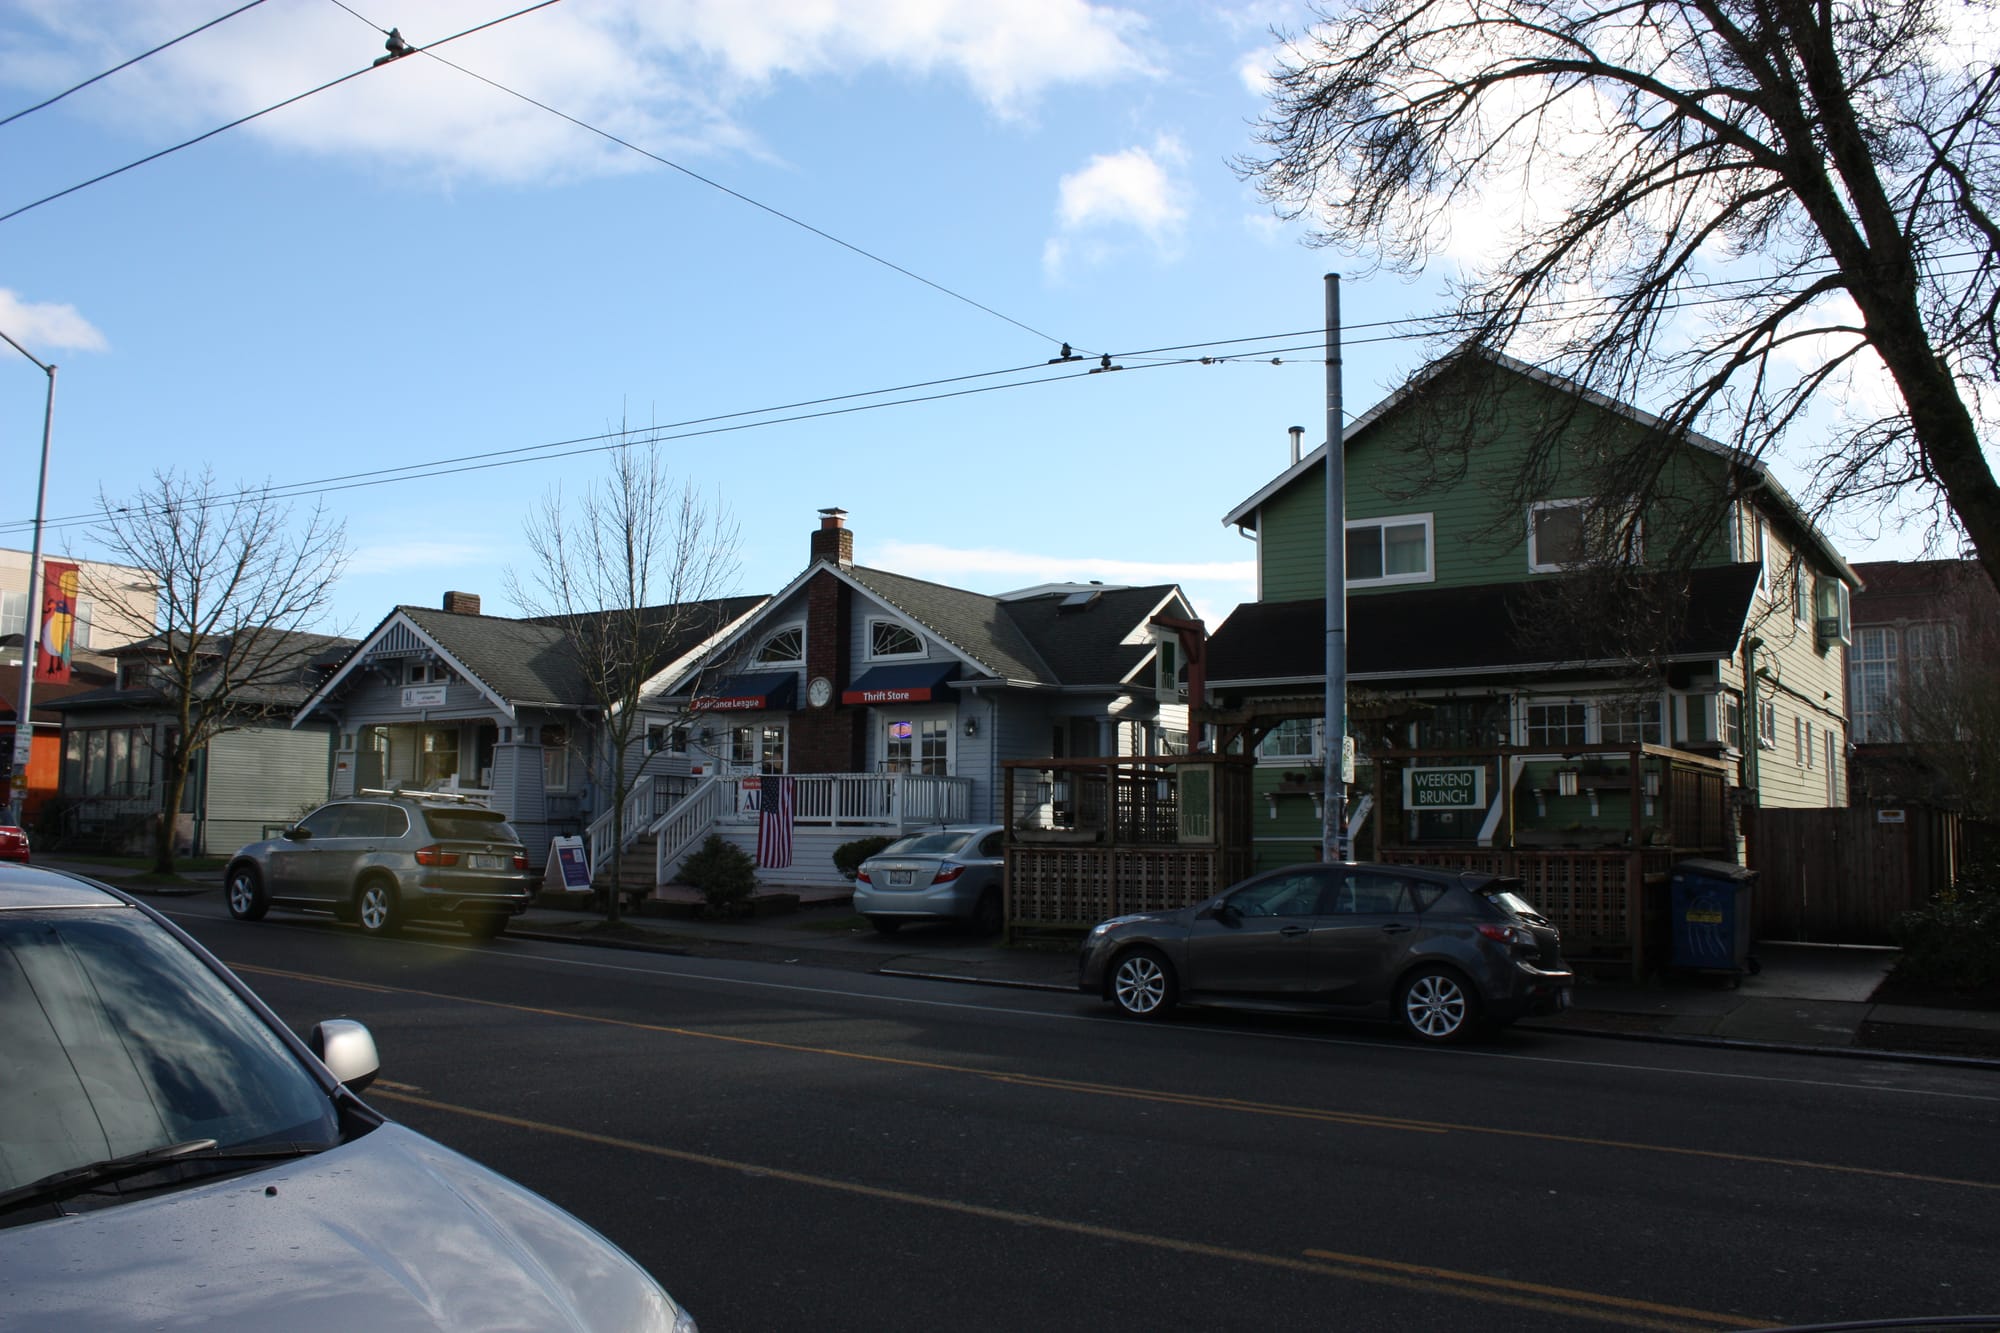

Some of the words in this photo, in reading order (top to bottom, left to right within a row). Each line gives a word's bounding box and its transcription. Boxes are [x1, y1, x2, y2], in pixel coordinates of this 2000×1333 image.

[863, 690, 886, 701] Thrift
[887, 690, 910, 700] Store
[696, 700, 731, 709] Assiance
[732, 698, 759, 709] League
[1415, 773, 1472, 787] WEEKEND
[1420, 789, 1468, 803] BRUNCH
